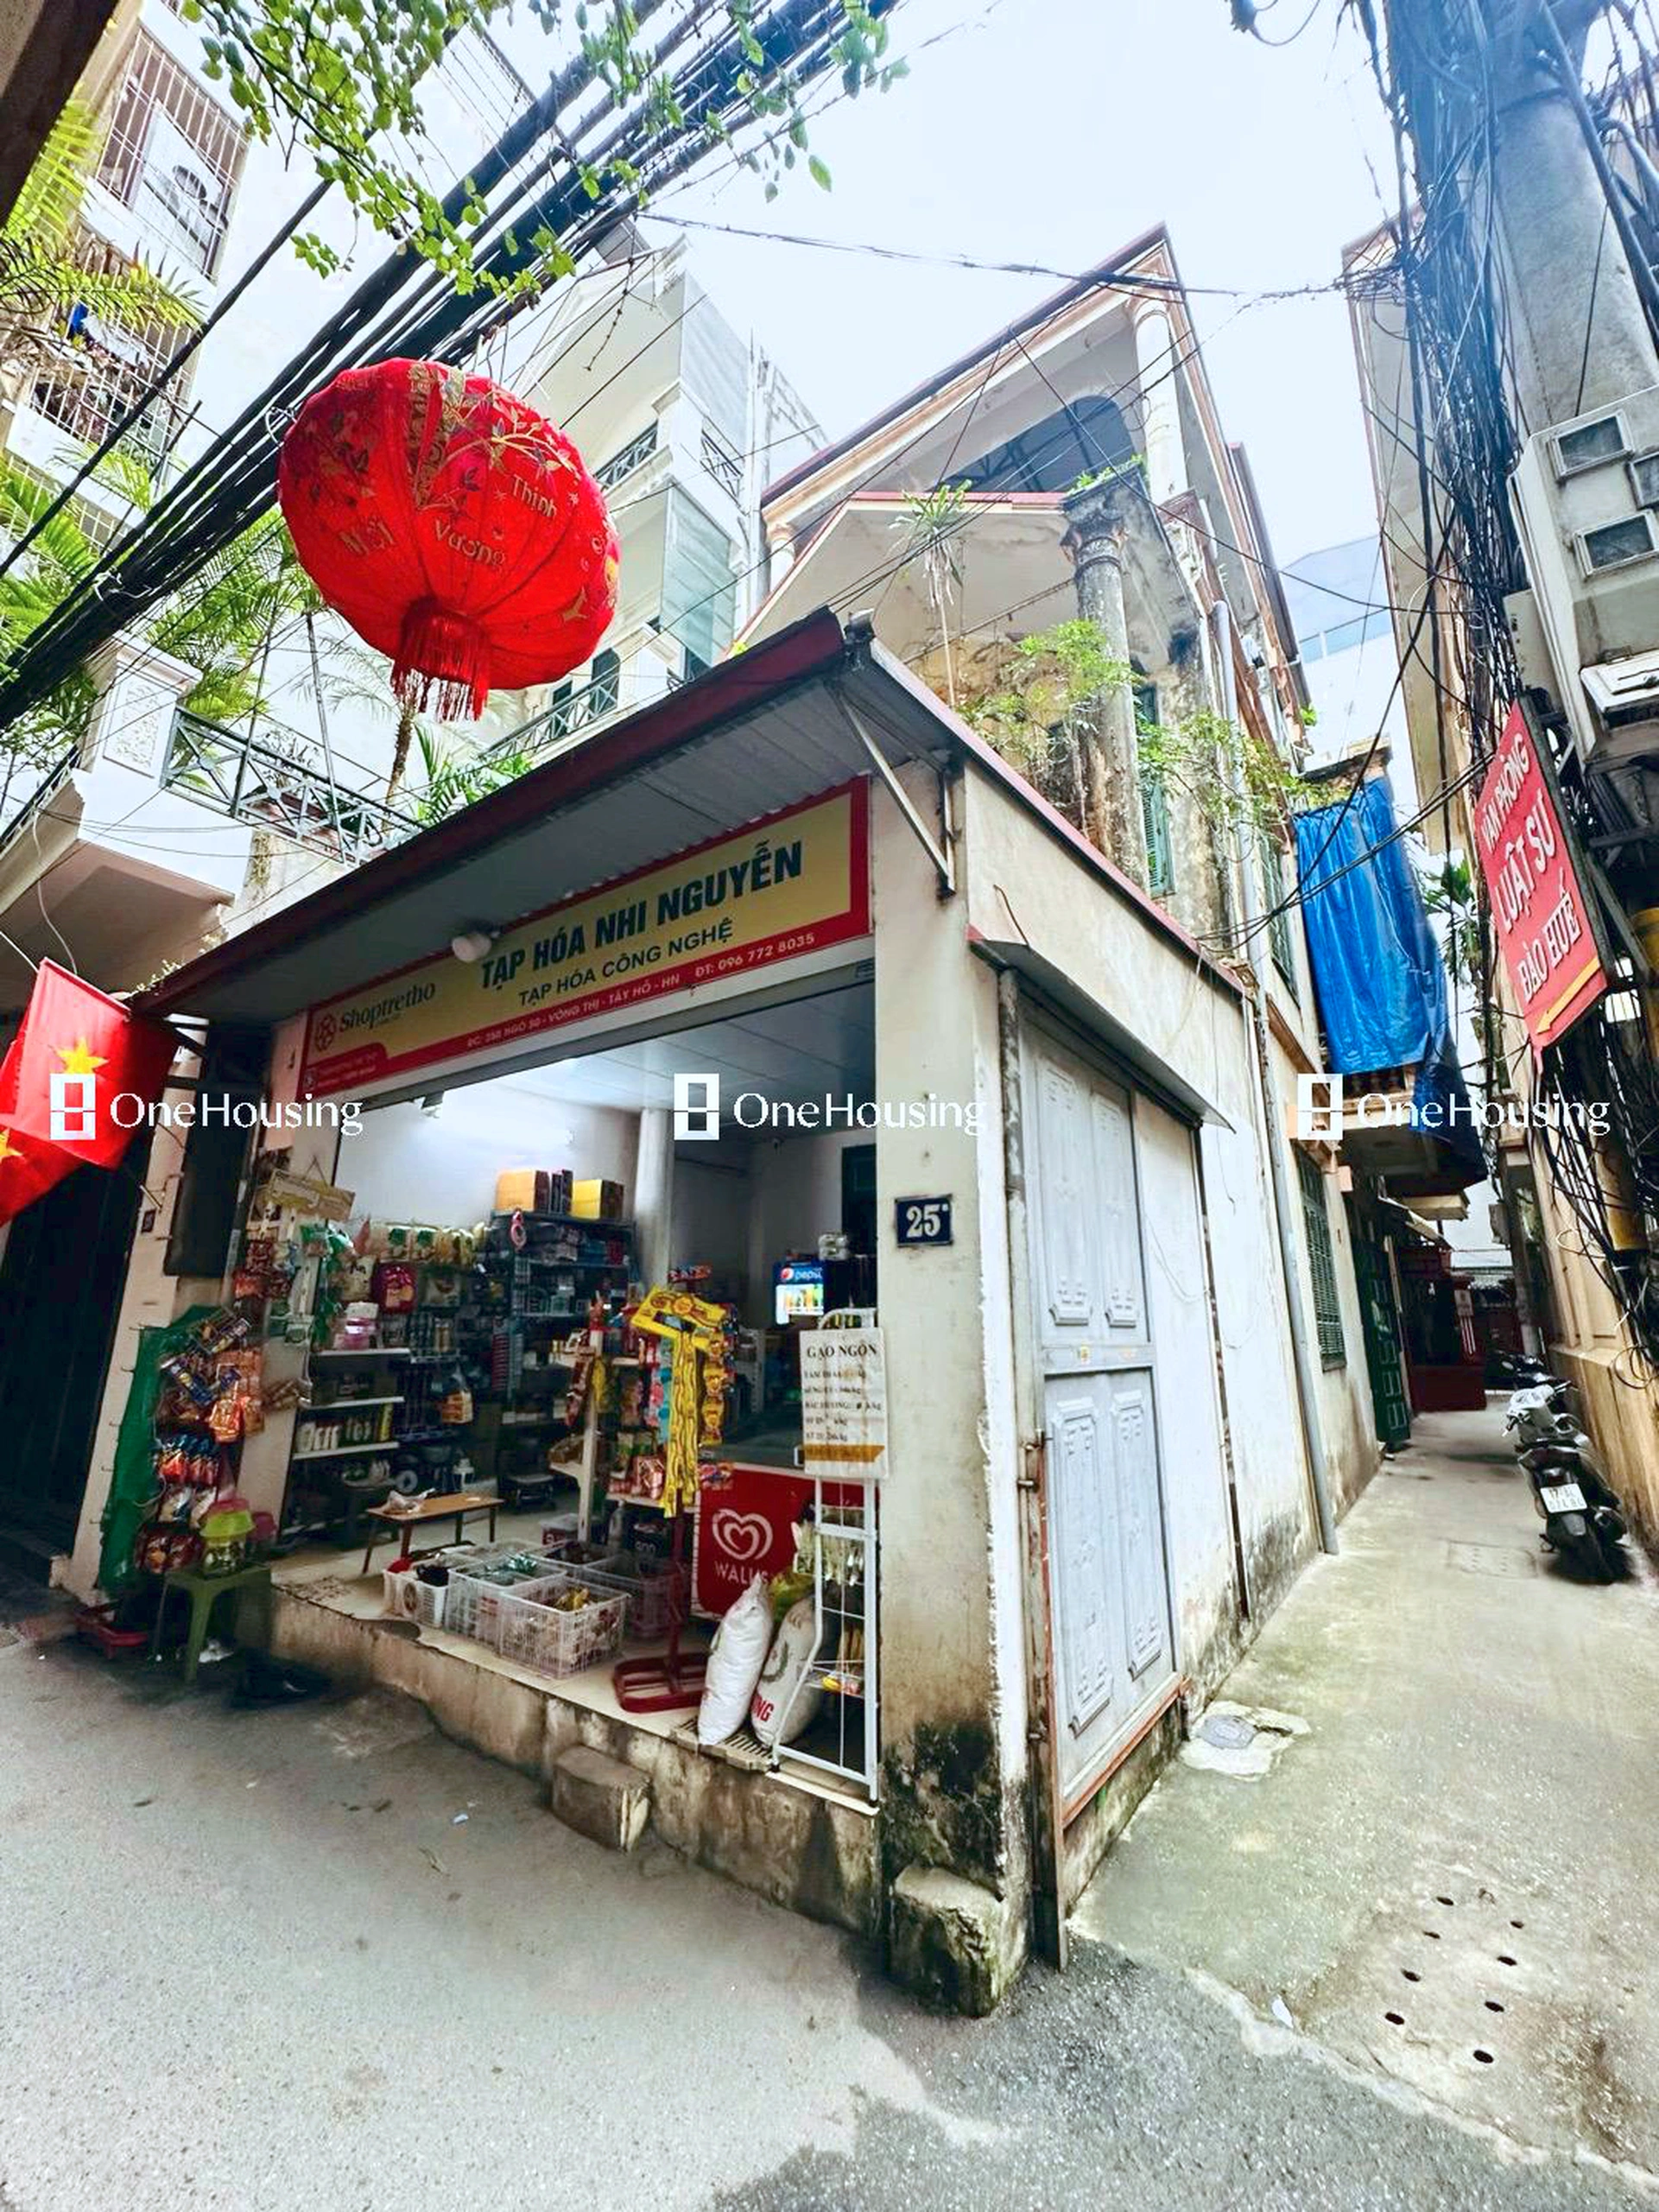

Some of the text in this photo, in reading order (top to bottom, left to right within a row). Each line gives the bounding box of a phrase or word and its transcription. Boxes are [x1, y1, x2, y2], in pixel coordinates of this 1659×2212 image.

[512, 473, 558, 519] Thịnh
[1494, 732, 1529, 822] PHÒNG
[1495, 787, 1555, 935] LUẬT SƯ
[481, 840, 801, 991] TẠP HÓA NHI NGUYỄN
[1542, 866, 1582, 969] HUẾ
[519, 916, 732, 1006] TẠP HÓA CÔNG NGHỆ
[662, 973, 680, 989] HN
[747, 945, 774, 962] 772
[777, 933, 815, 953] 8035
[807, 1346, 835, 1360] GẠO
